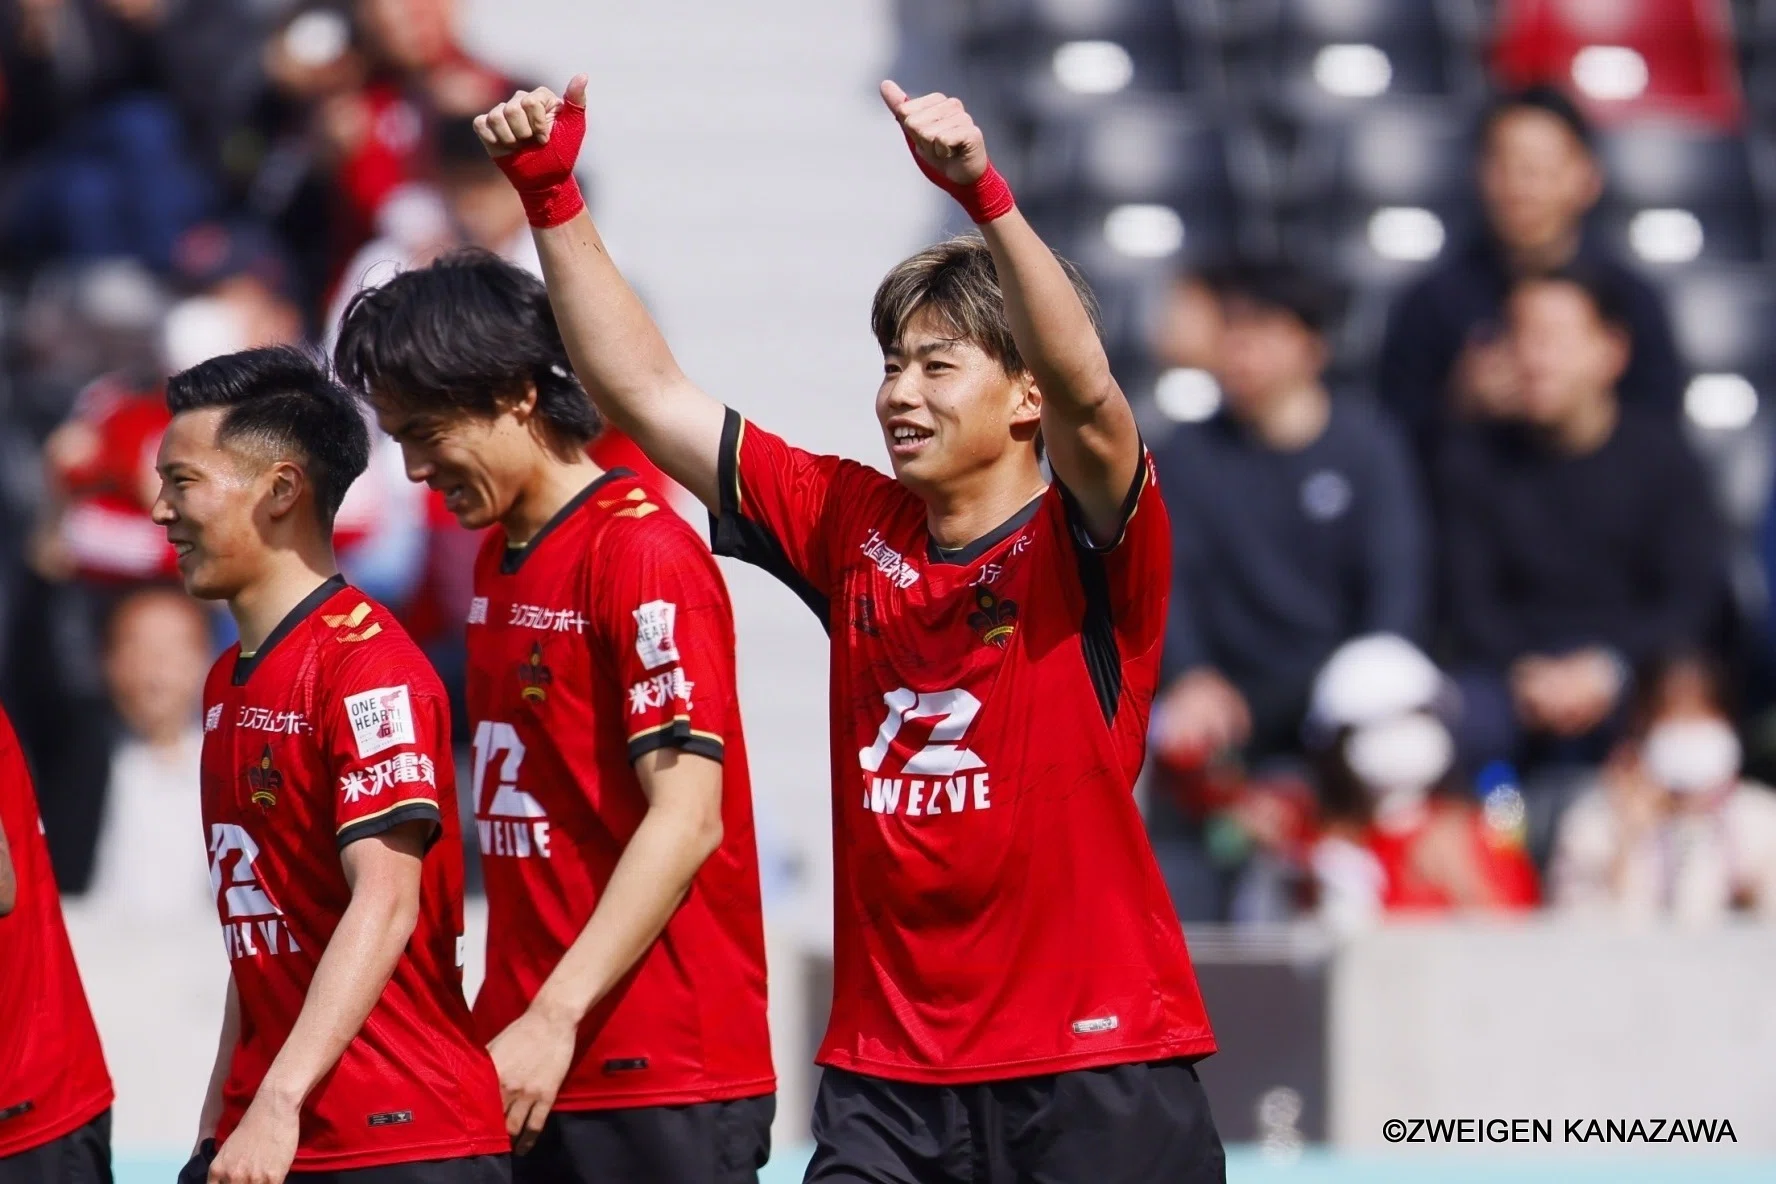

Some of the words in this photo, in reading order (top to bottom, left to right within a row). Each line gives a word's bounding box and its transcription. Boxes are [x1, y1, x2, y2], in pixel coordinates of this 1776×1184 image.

[236, 706, 313, 736] システムサポー
[351, 697, 377, 717] ONE
[340, 752, 437, 803] 米沢電気
[863, 772, 991, 816] WELVE
